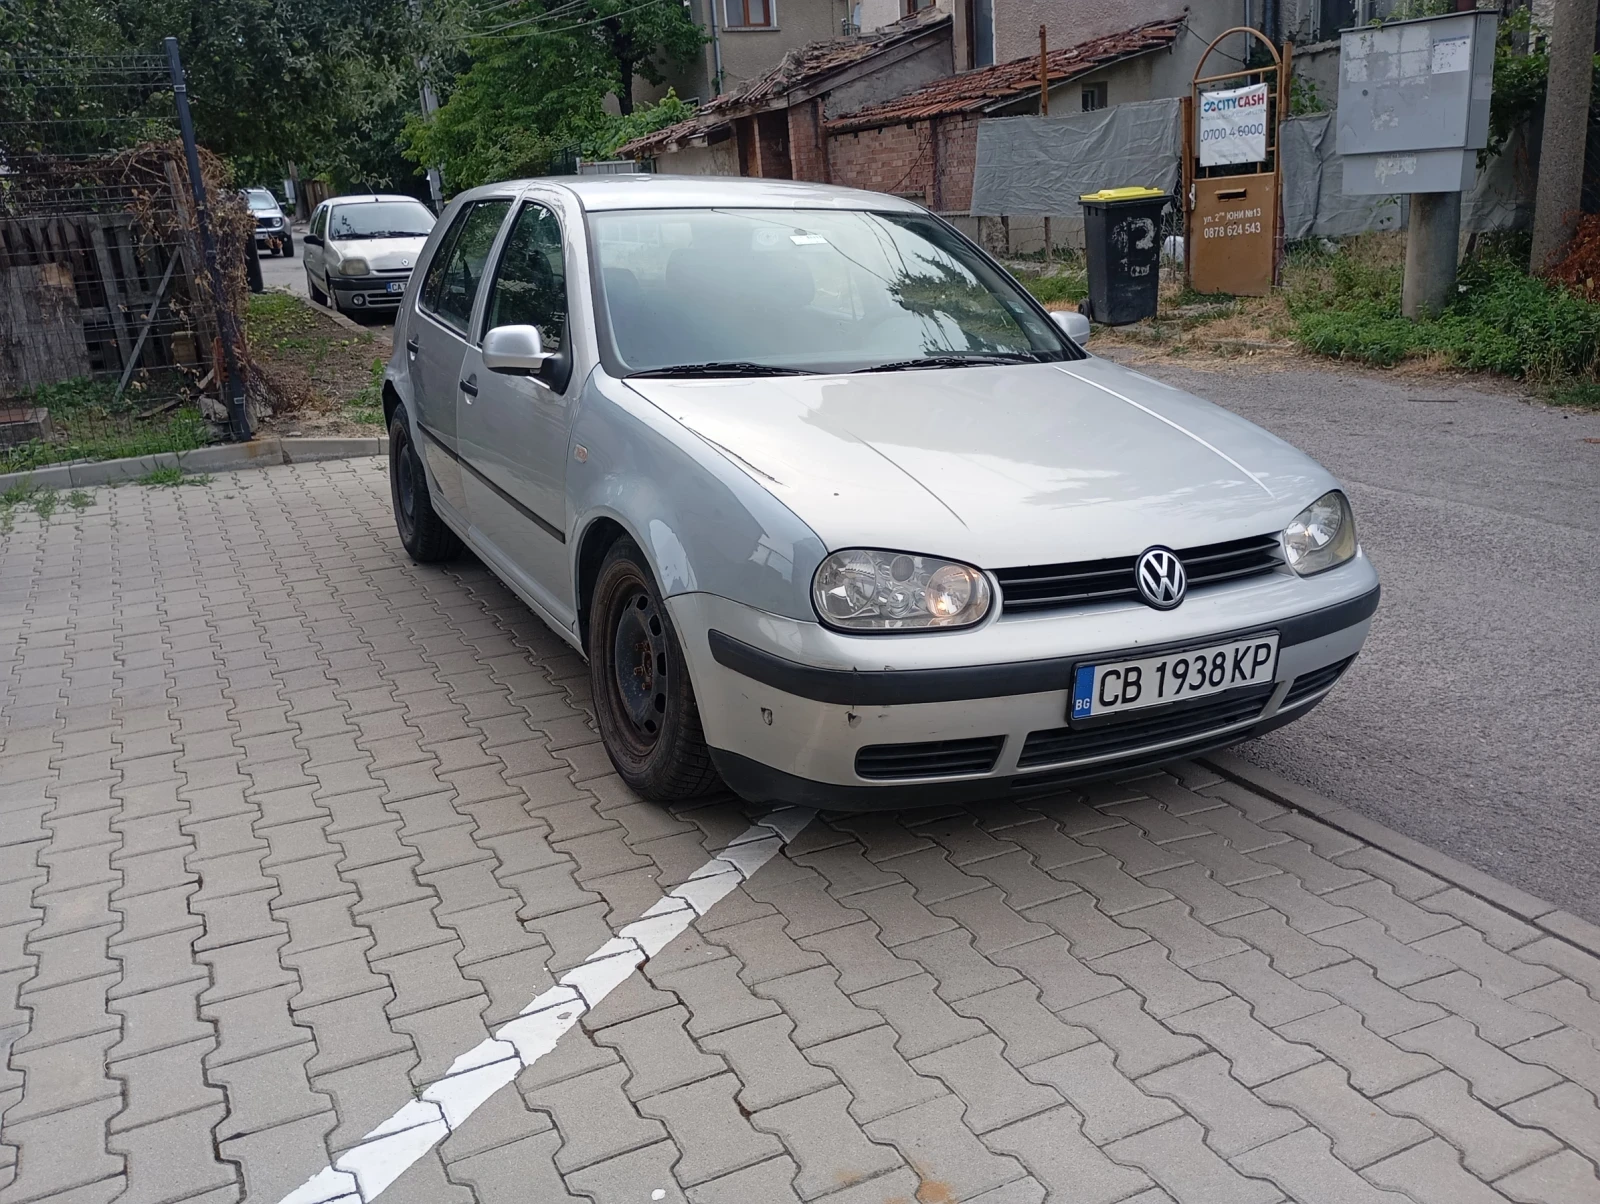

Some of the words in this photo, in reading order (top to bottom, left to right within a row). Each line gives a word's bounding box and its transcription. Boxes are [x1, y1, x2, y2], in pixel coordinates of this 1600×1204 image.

[1203, 128, 1227, 141] 0700
[1229, 127, 1236, 136] 4
[1237, 123, 1264, 137] 6000
[1203, 215, 1214, 225] ул.
[1226, 209, 1244, 221] ЮНИ
[1204, 226, 1225, 239] 0878
[1227, 224, 1243, 236] 624
[1245, 221, 1261, 234] 543
[1099, 666, 1143, 708] CB
[1075, 698, 1091, 711] BG
